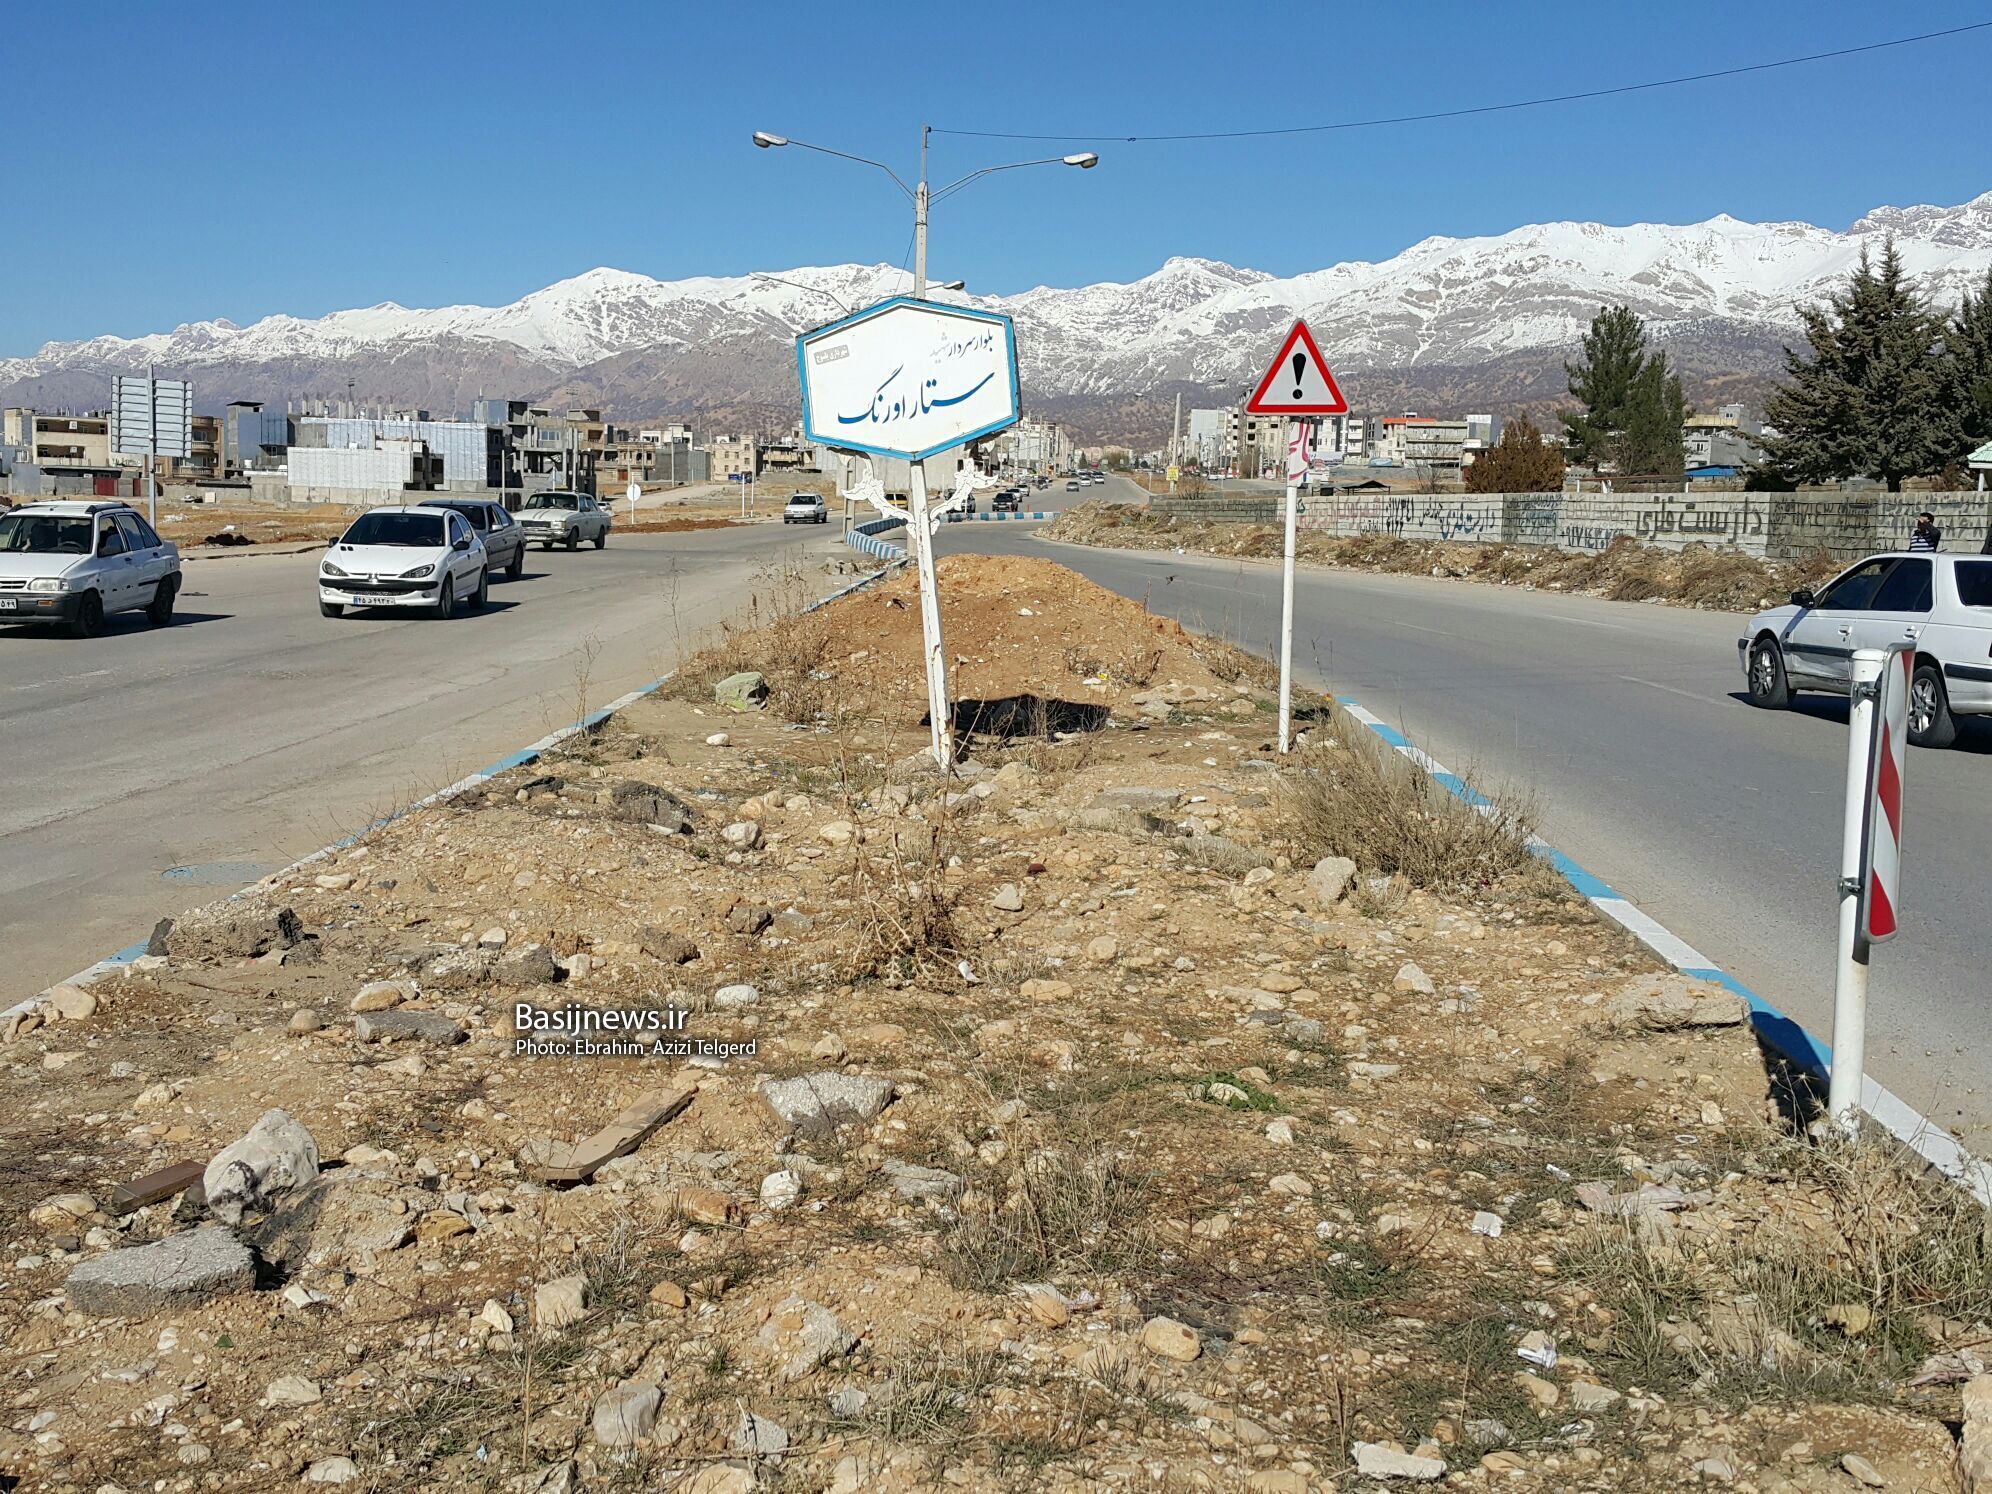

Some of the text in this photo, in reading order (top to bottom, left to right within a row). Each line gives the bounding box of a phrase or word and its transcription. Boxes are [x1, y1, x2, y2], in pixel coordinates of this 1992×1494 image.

[948, 336, 976, 358] سردار
[973, 328, 993, 352] بلوار
[908, 371, 995, 419] ستار
[1464, 505, 1495, 541] داربست
[1635, 495, 1675, 540] فلزی
[1679, 496, 1763, 544] داربست
